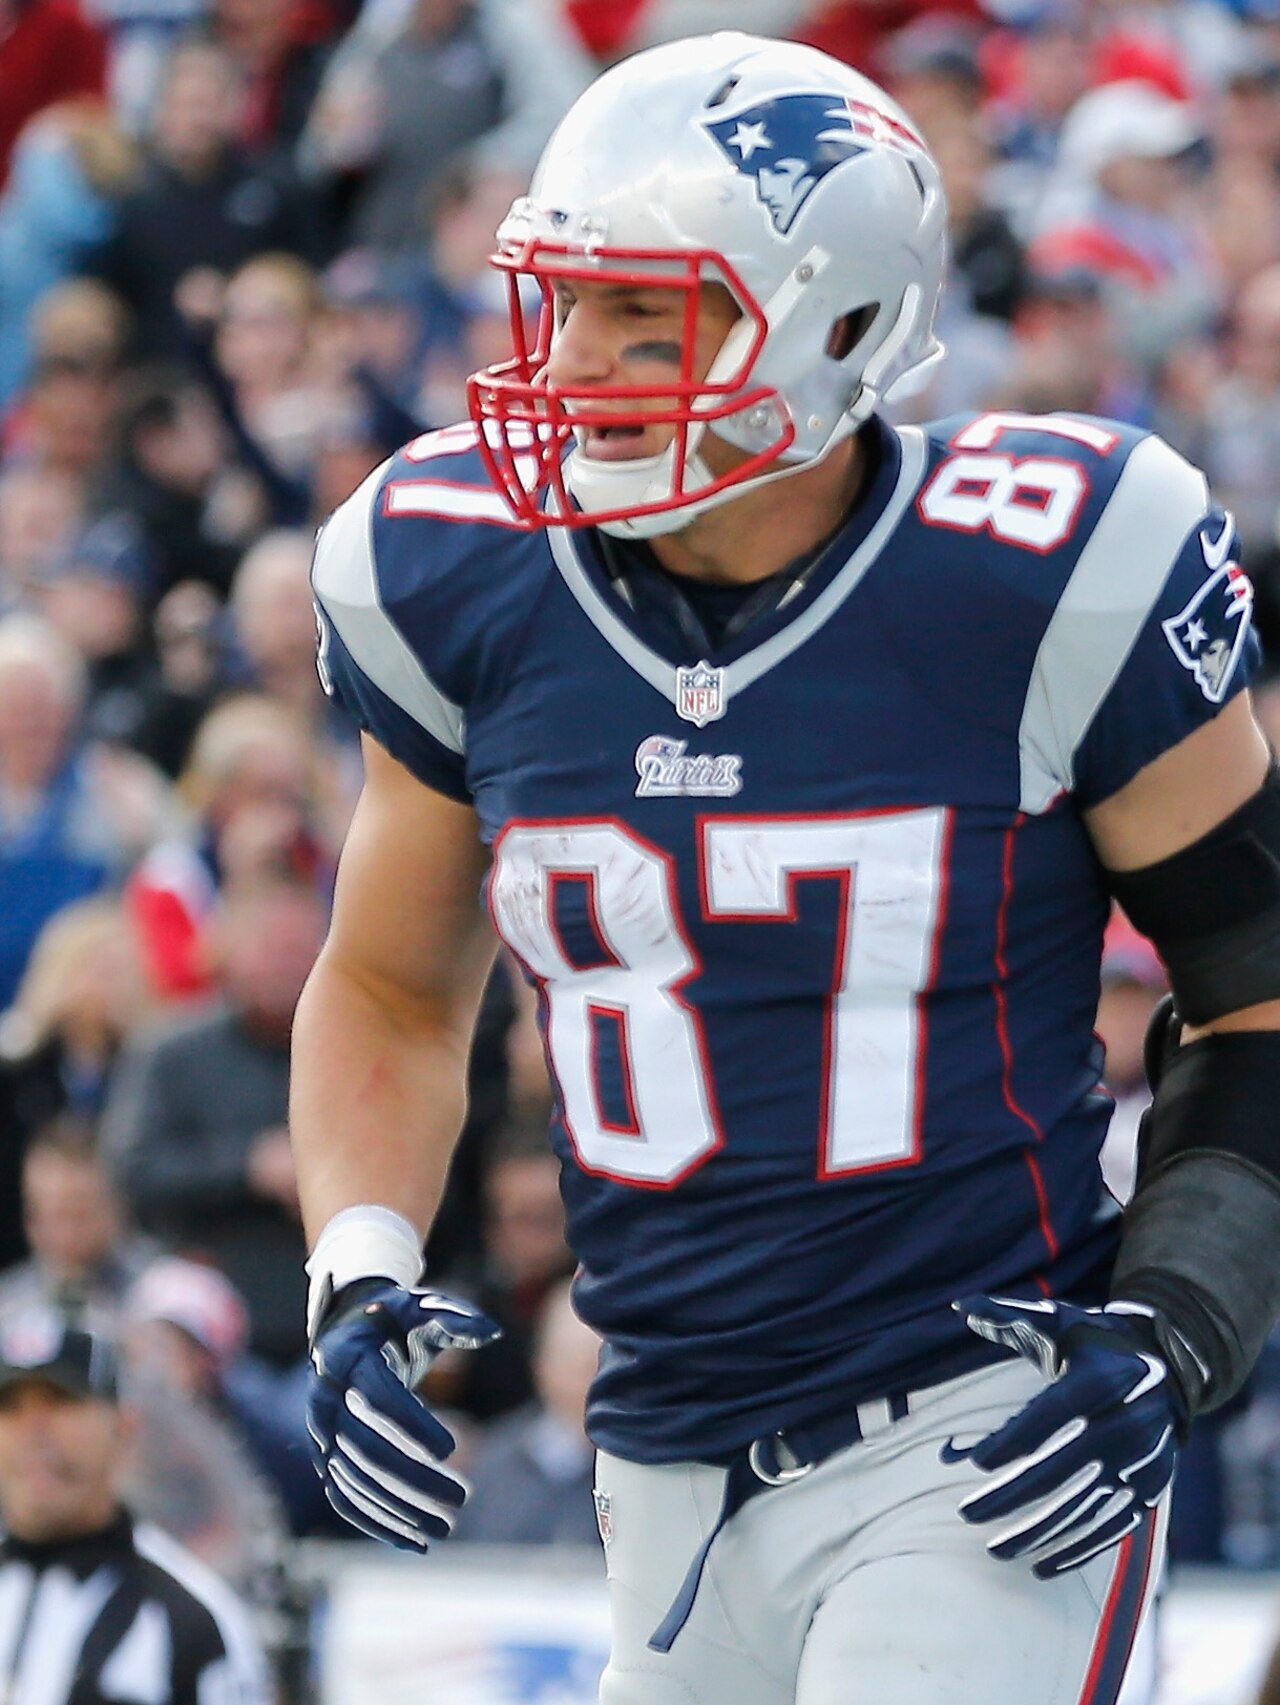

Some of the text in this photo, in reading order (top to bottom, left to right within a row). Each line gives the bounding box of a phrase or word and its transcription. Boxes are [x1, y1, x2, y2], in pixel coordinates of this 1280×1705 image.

[915, 411, 1121, 556] 87
[683, 688, 717, 714] NFL
[634, 737, 744, 797] Patriots
[491, 805, 952, 1190] 87
